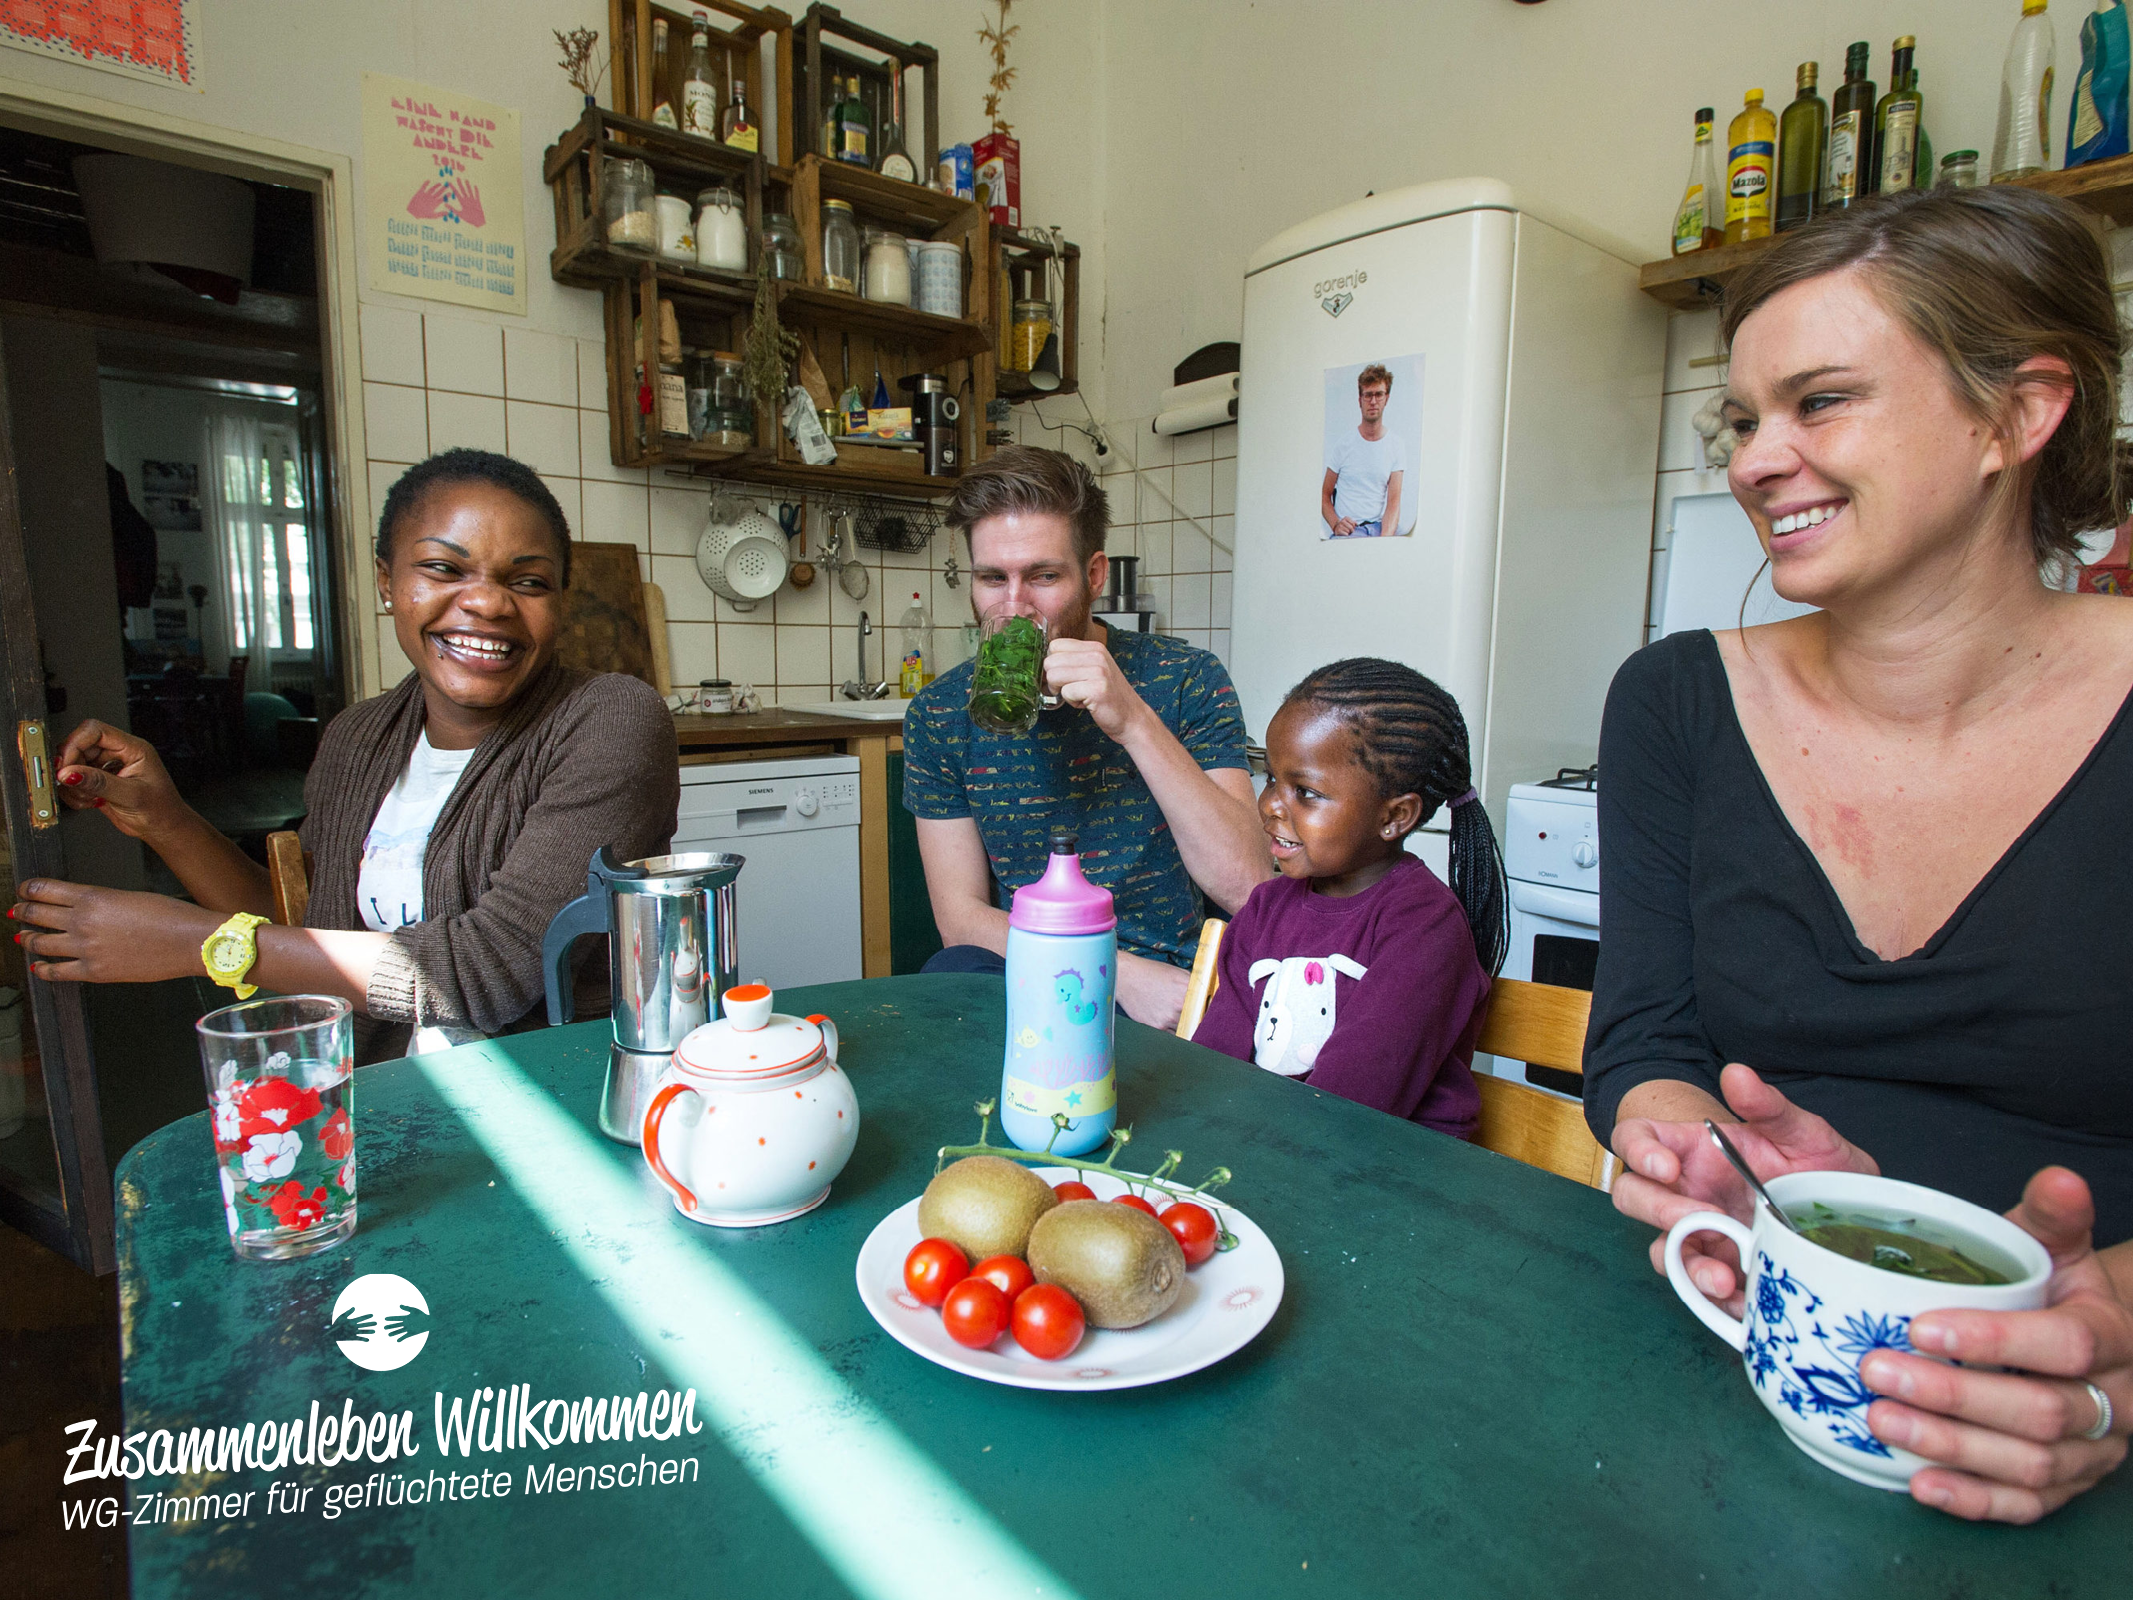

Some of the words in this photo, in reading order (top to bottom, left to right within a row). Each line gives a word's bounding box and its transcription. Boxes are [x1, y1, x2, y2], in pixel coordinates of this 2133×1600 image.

[391, 96, 442, 119] EINE
[449, 109, 496, 131] HAND
[413, 133, 484, 161] ANDERE
[459, 127, 494, 149] DIE
[1732, 174, 1766, 190] Mazola
[1313, 269, 1368, 299] gorenje
[748, 787, 774, 795] SIEMENS
